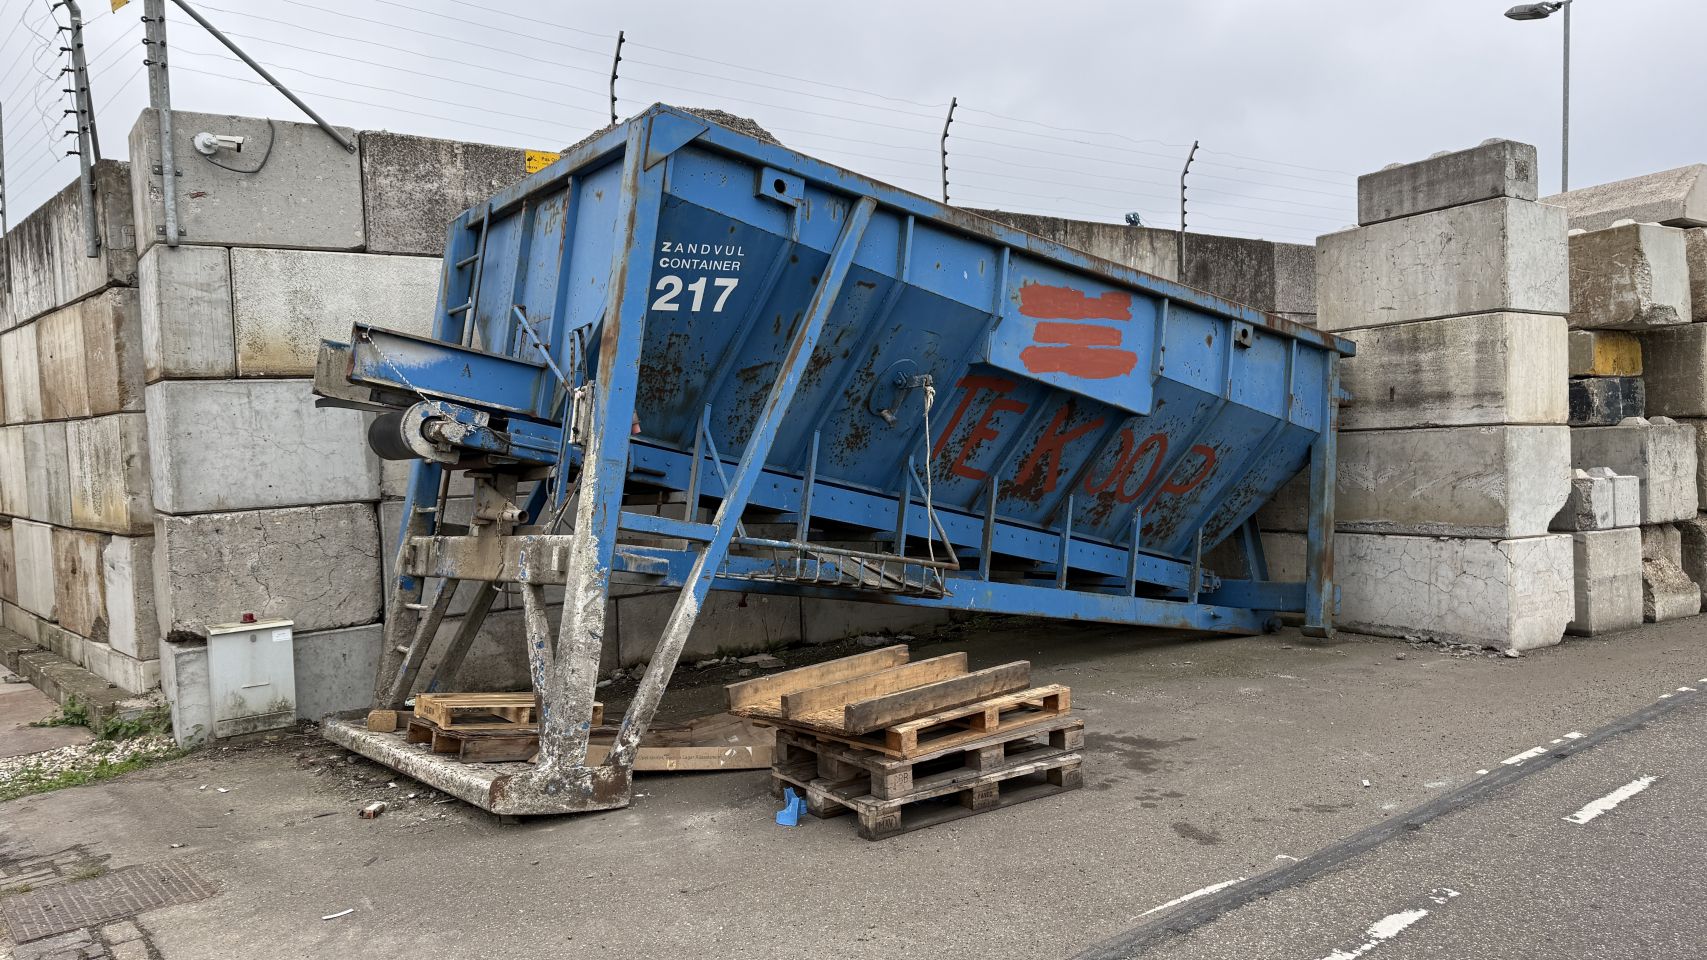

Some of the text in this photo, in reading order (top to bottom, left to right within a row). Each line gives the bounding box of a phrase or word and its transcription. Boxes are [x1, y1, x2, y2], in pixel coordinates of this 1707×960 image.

[661, 242, 745, 256] ZANDVUL
[660, 258, 741, 271] CONTAINER
[651, 275, 739, 313] 217
[931, 374, 1029, 481] TE
